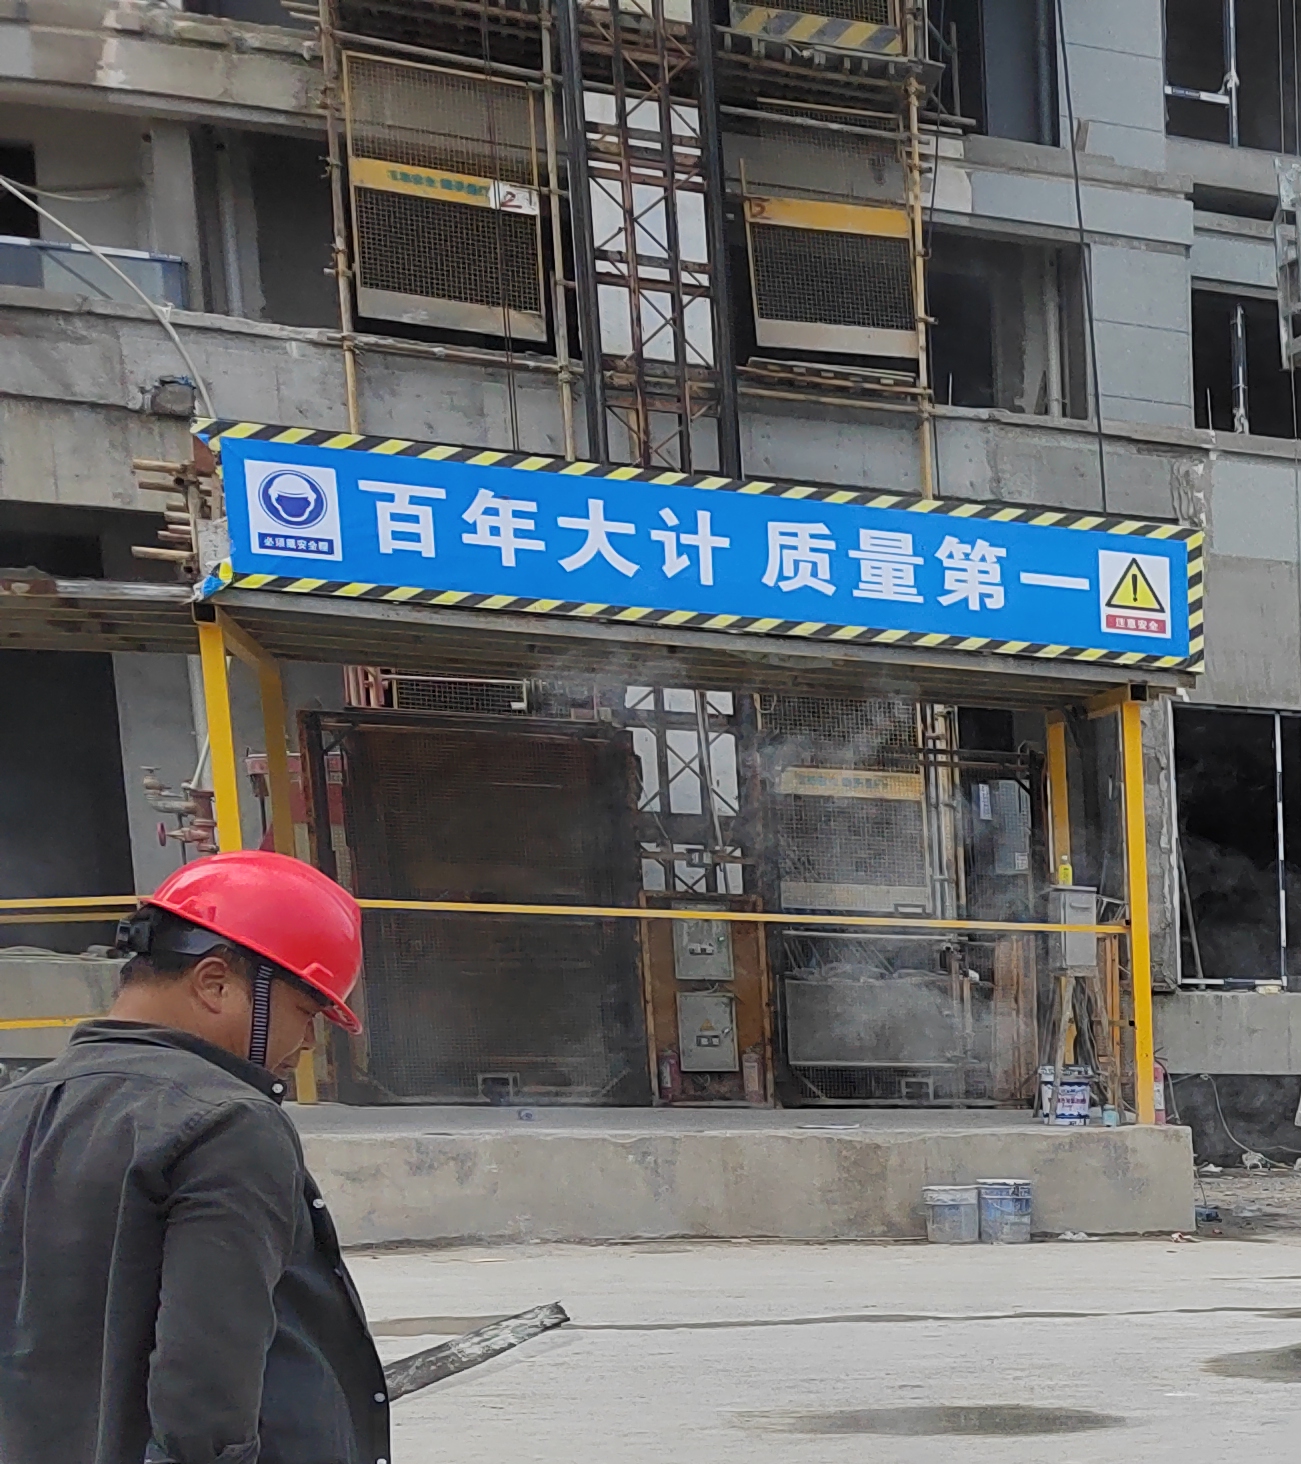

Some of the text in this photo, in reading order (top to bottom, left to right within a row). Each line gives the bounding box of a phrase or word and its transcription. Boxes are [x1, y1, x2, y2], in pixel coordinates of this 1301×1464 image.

[357, 479, 1091, 611] 百年大计 质量第一
[1115, 617, 1159, 631] 注意安全
